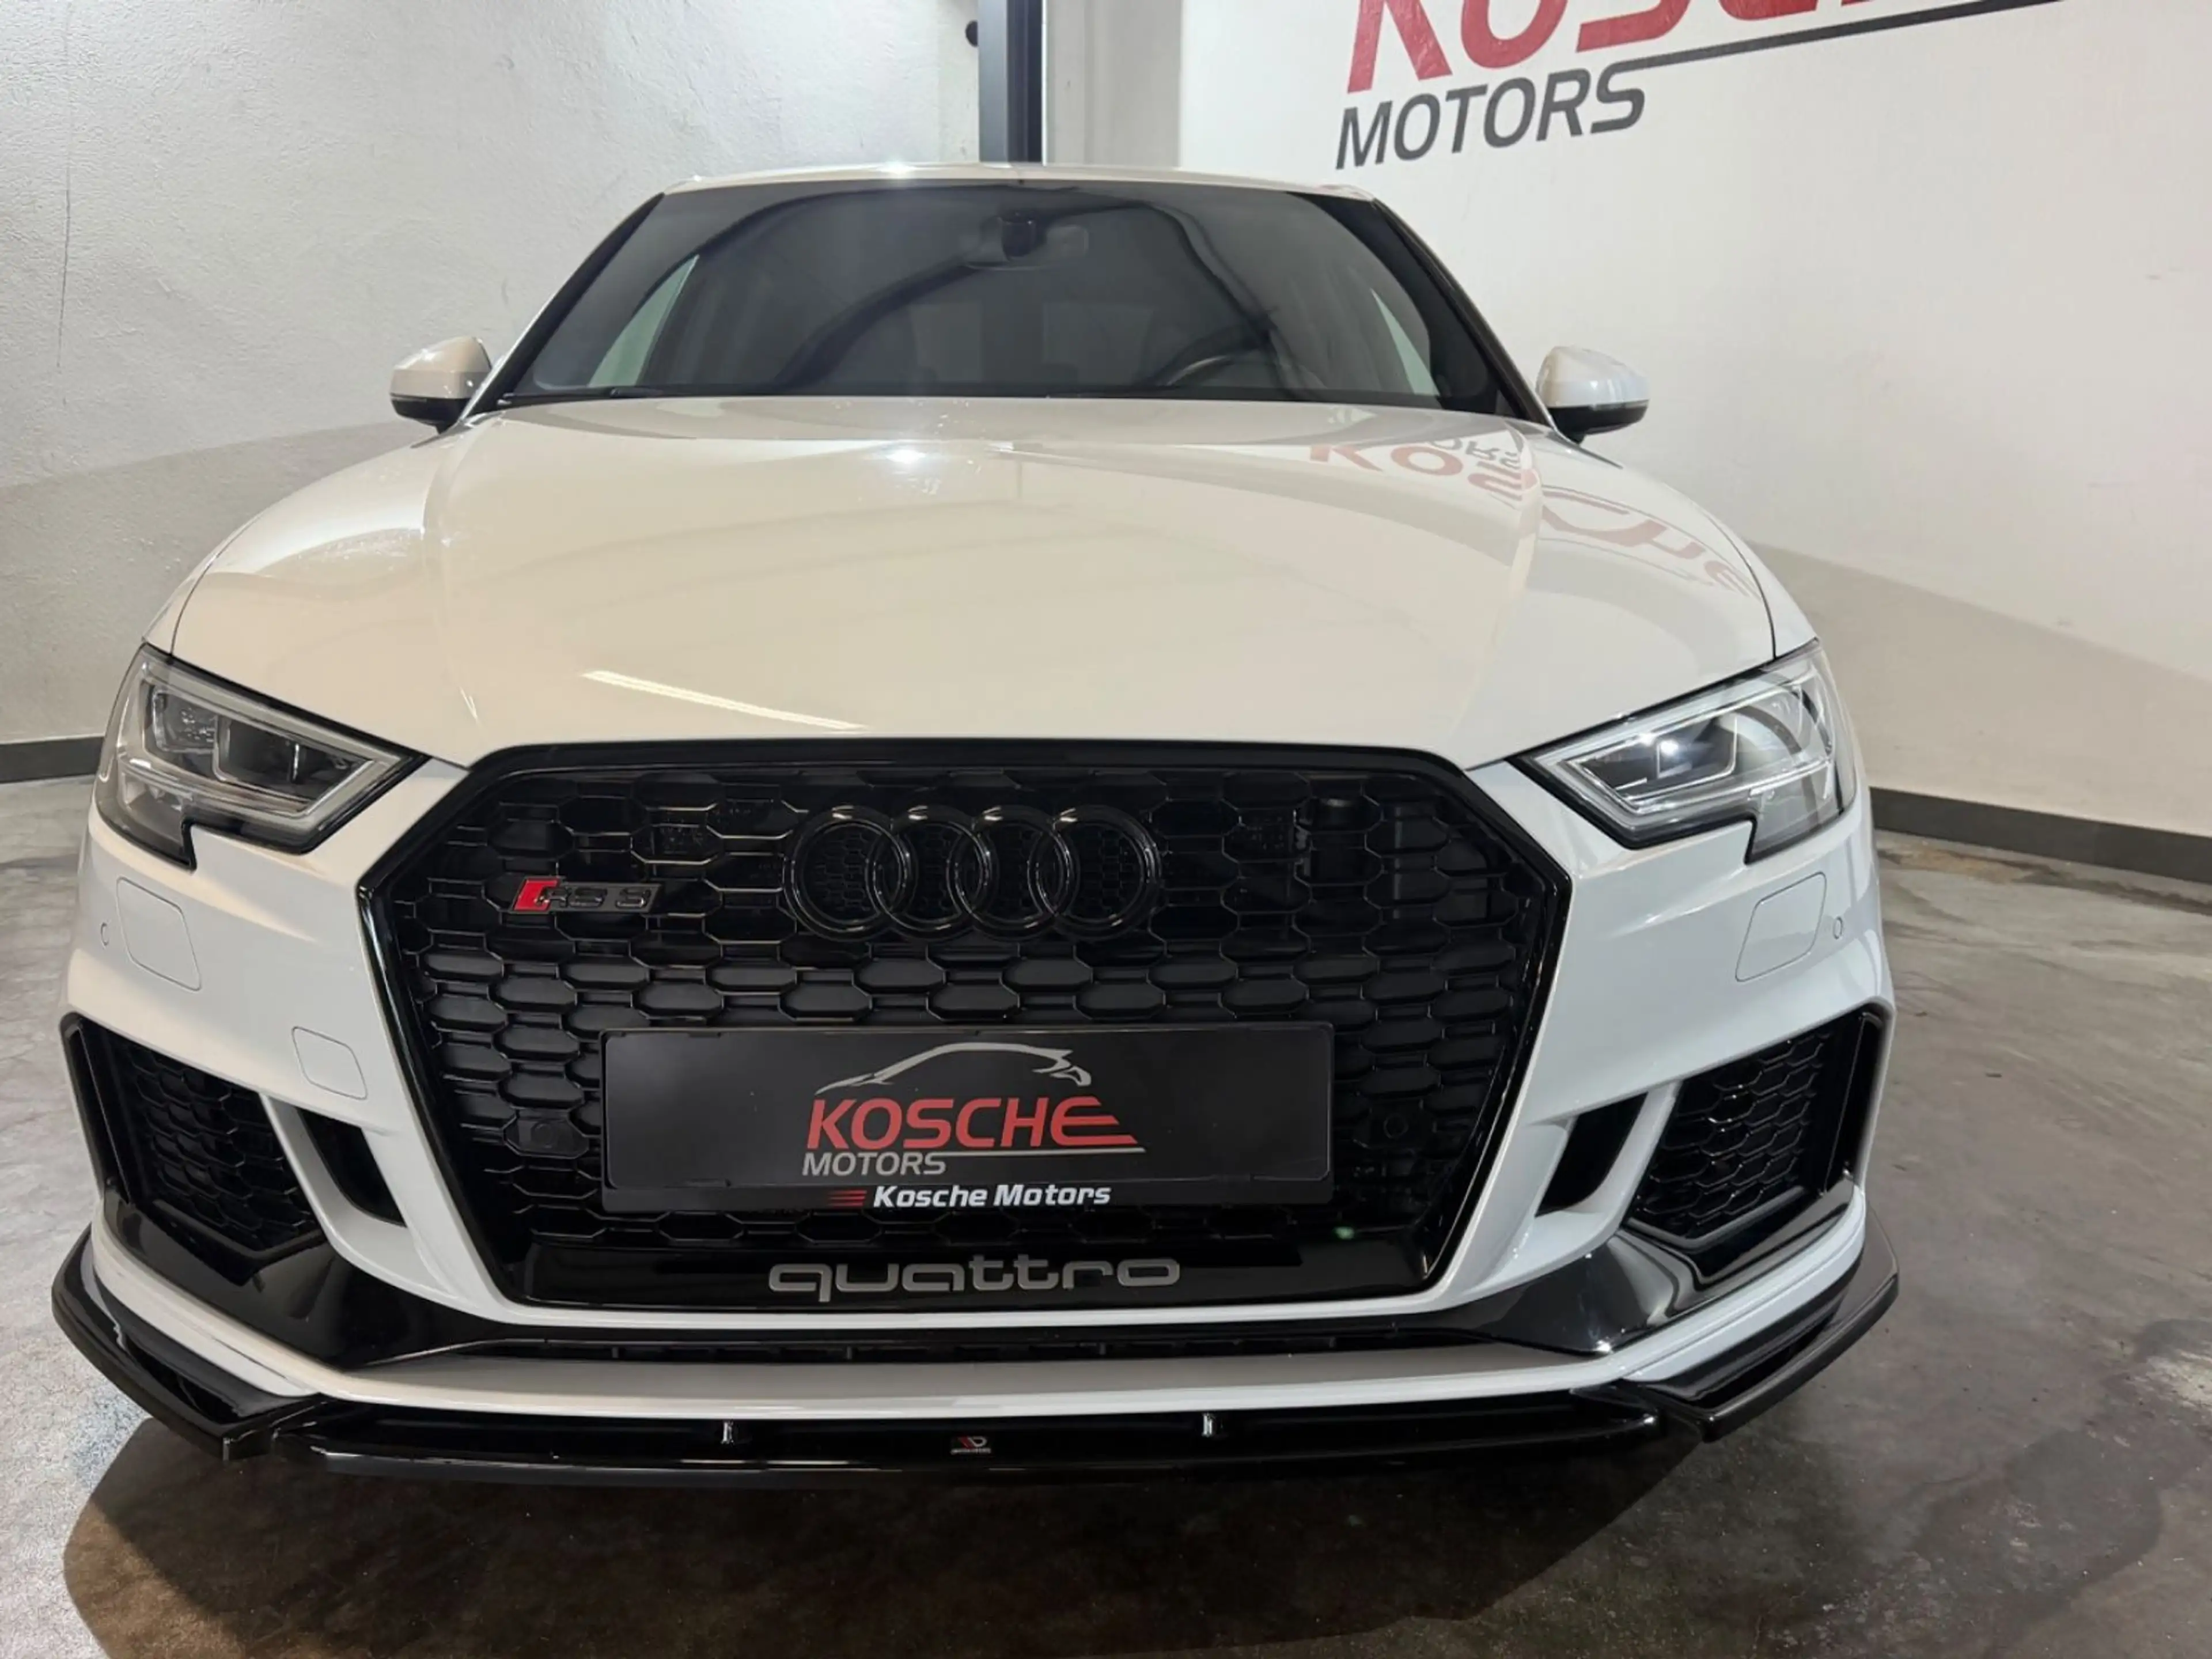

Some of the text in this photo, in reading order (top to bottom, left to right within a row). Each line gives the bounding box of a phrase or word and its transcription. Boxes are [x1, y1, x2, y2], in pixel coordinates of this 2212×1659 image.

[1335, 56, 1646, 170] MOTORS
[806, 1096, 1138, 1150] KOSCHE
[802, 1150, 946, 1176] MOTORS
[873, 1184, 1111, 1207] Kosche Motors
[768, 1253, 1180, 1302] quattro
